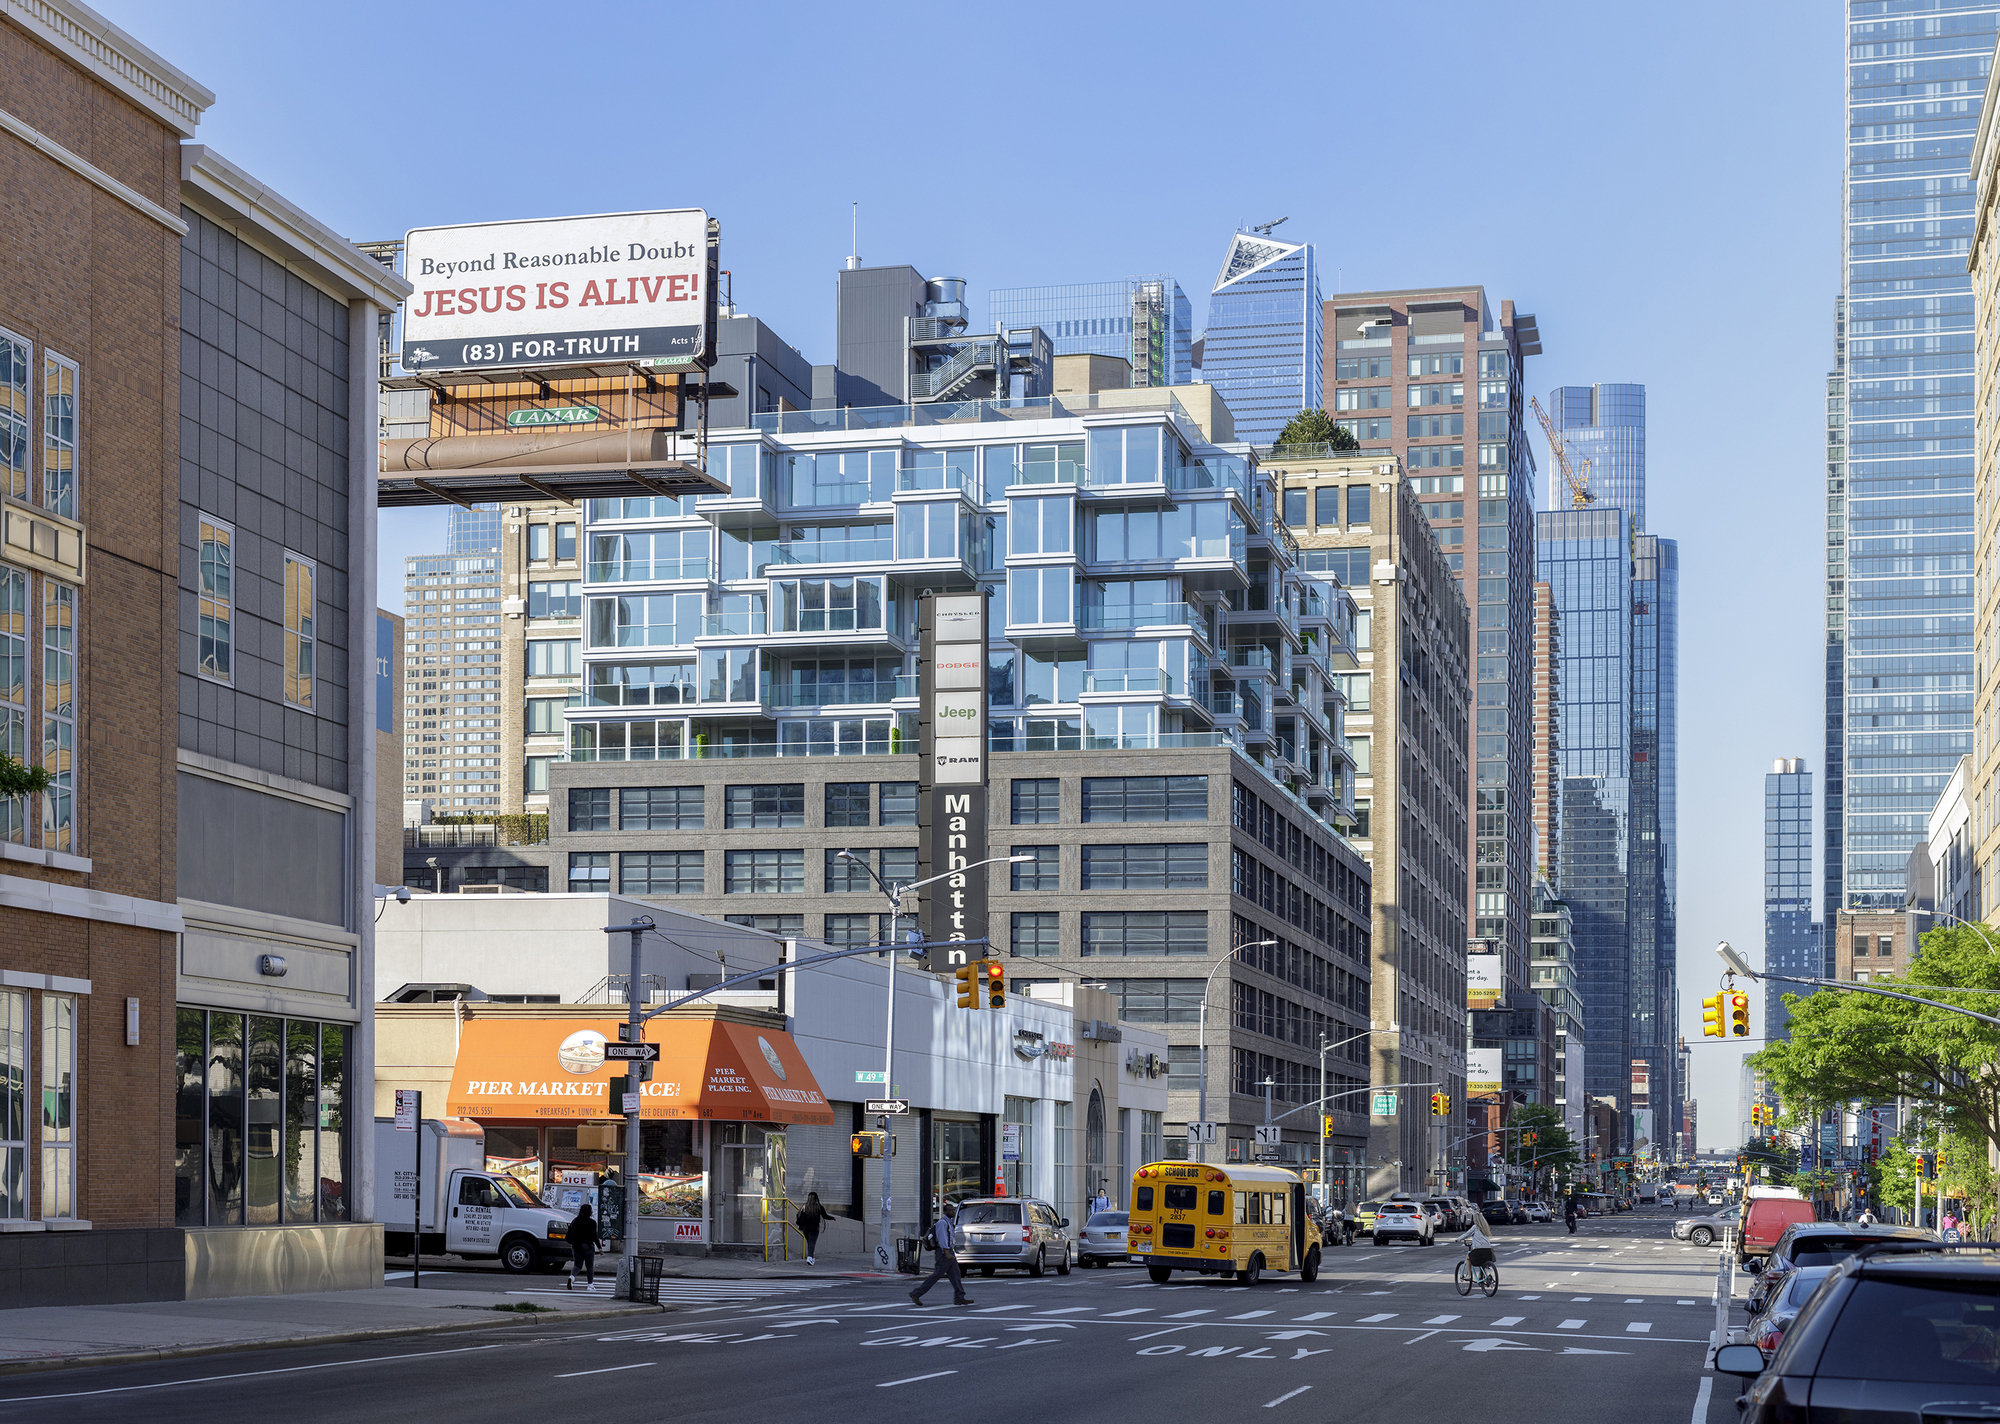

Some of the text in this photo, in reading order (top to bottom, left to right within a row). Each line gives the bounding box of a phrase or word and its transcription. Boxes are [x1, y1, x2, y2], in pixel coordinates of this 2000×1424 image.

[420, 241, 695, 279] Beyond Reasonable Doubt
[414, 274, 698, 317] JESUS IS ALIVE!
[462, 343, 504, 363] (83)
[512, 335, 639, 358] FOR-TRUTH
[515, 408, 590, 424] LAMAR
[938, 706, 976, 720] Jeep
[945, 794, 970, 964] Manhattan
[612, 1048, 652, 1056] ONE WAY
[1052, 1042, 1074, 1058] DODGE
[857, 1072, 864, 1081] W
[866, 1073, 876, 1081] 49
[466, 1081, 675, 1096] PIER MARKET ACE
[457, 1106, 492, 1115] 212.245.5551
[540, 1108, 596, 1116] BREAKFAST LUNCH
[640, 1108, 680, 1117] REE DELIVERY
[1165, 1167, 1199, 1178] SCHOOL BUS
[676, 1224, 700, 1236] ATM
[597, 1333, 798, 1344] ONLY
[860, 1336, 1062, 1348] ONLY
[1136, 1345, 1334, 1360] ONLY
